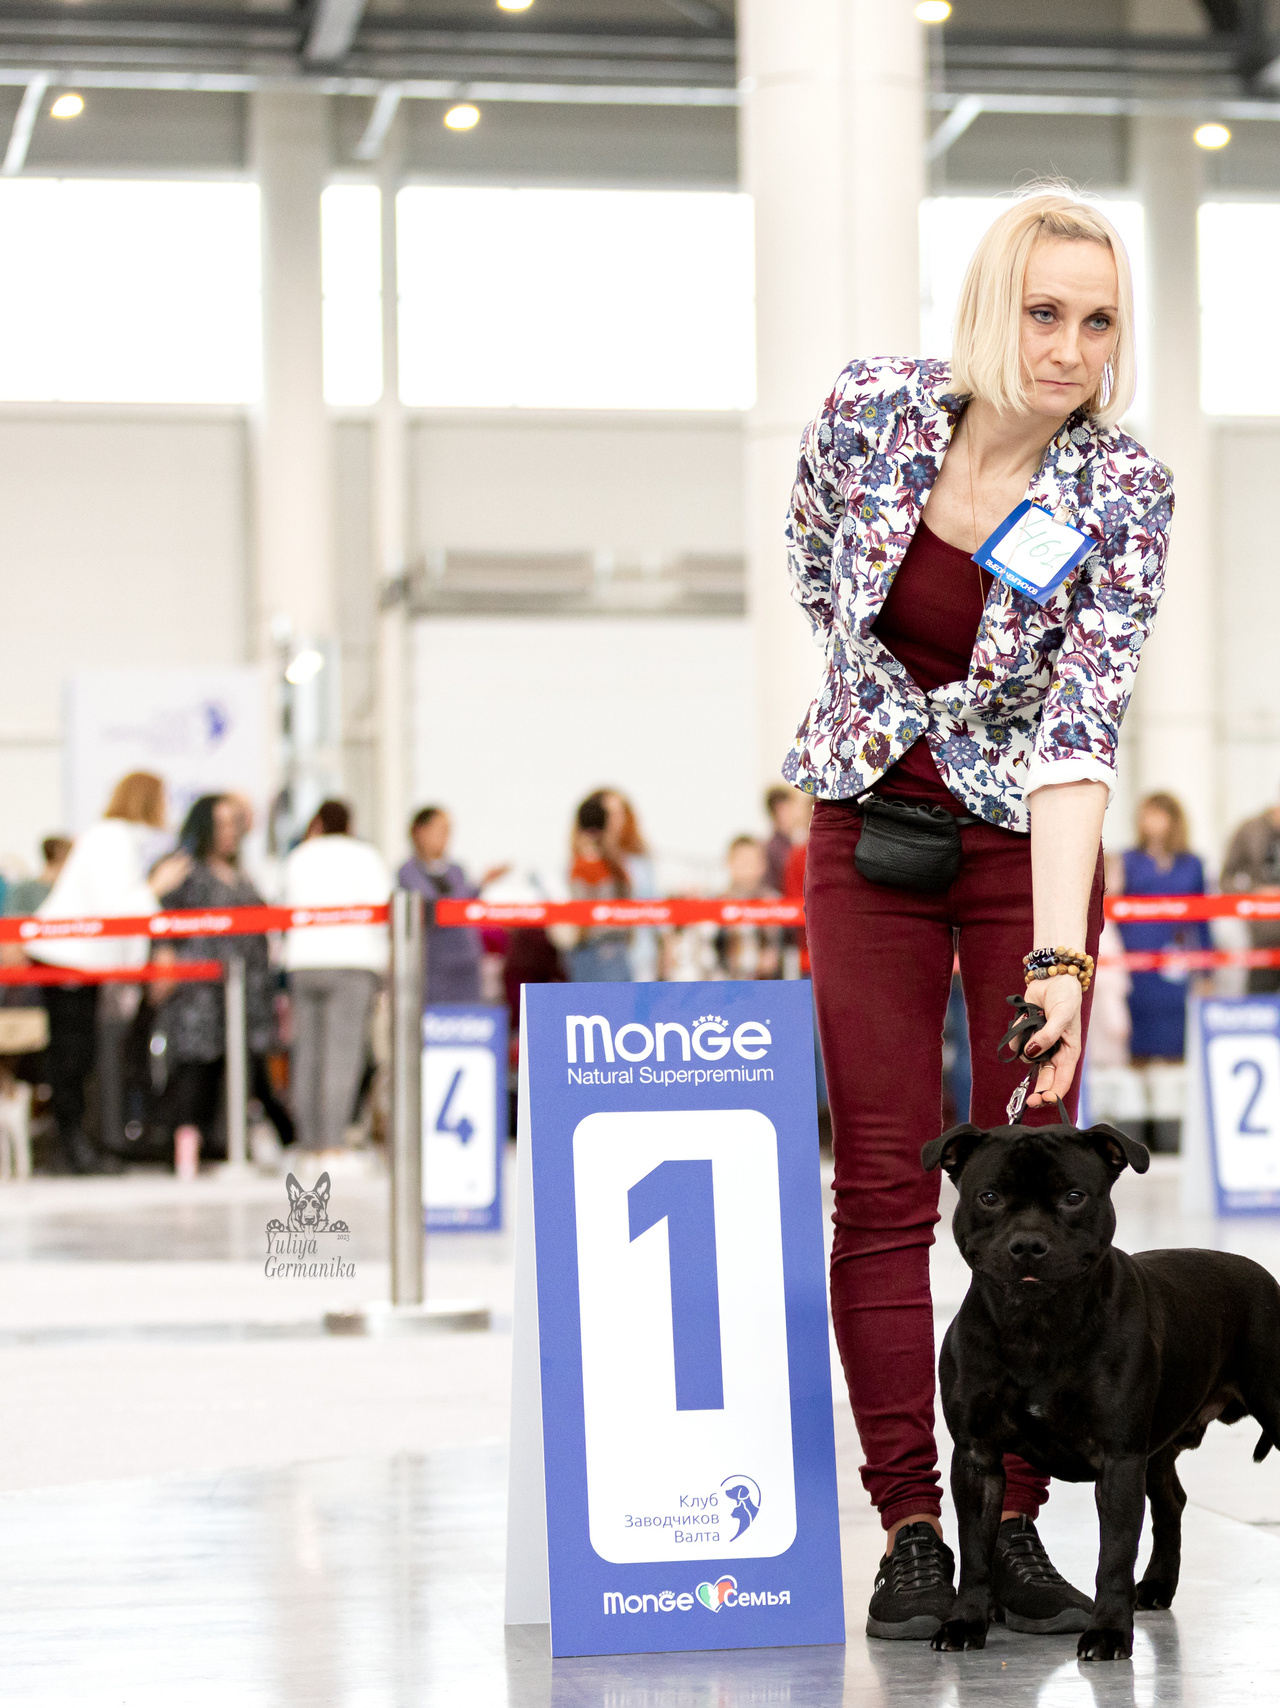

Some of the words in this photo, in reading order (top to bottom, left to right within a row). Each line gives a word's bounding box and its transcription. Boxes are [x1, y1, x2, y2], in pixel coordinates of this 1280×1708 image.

[1016, 518, 1071, 569] 461
[1005, 571, 1039, 596] ЧЕМПИОНОВ
[567, 1067, 633, 1085] Natural
[639, 1065, 774, 1087] Superpremium
[435, 1067, 475, 1146] 4
[1231, 1058, 1270, 1135] 2
[627, 1159, 725, 1411] 1
[679, 1492, 719, 1510] Клуб
[624, 1512, 720, 1529] Заводчиков
[674, 1529, 720, 1544] Валта
[723, 1588, 791, 1608] Семья
